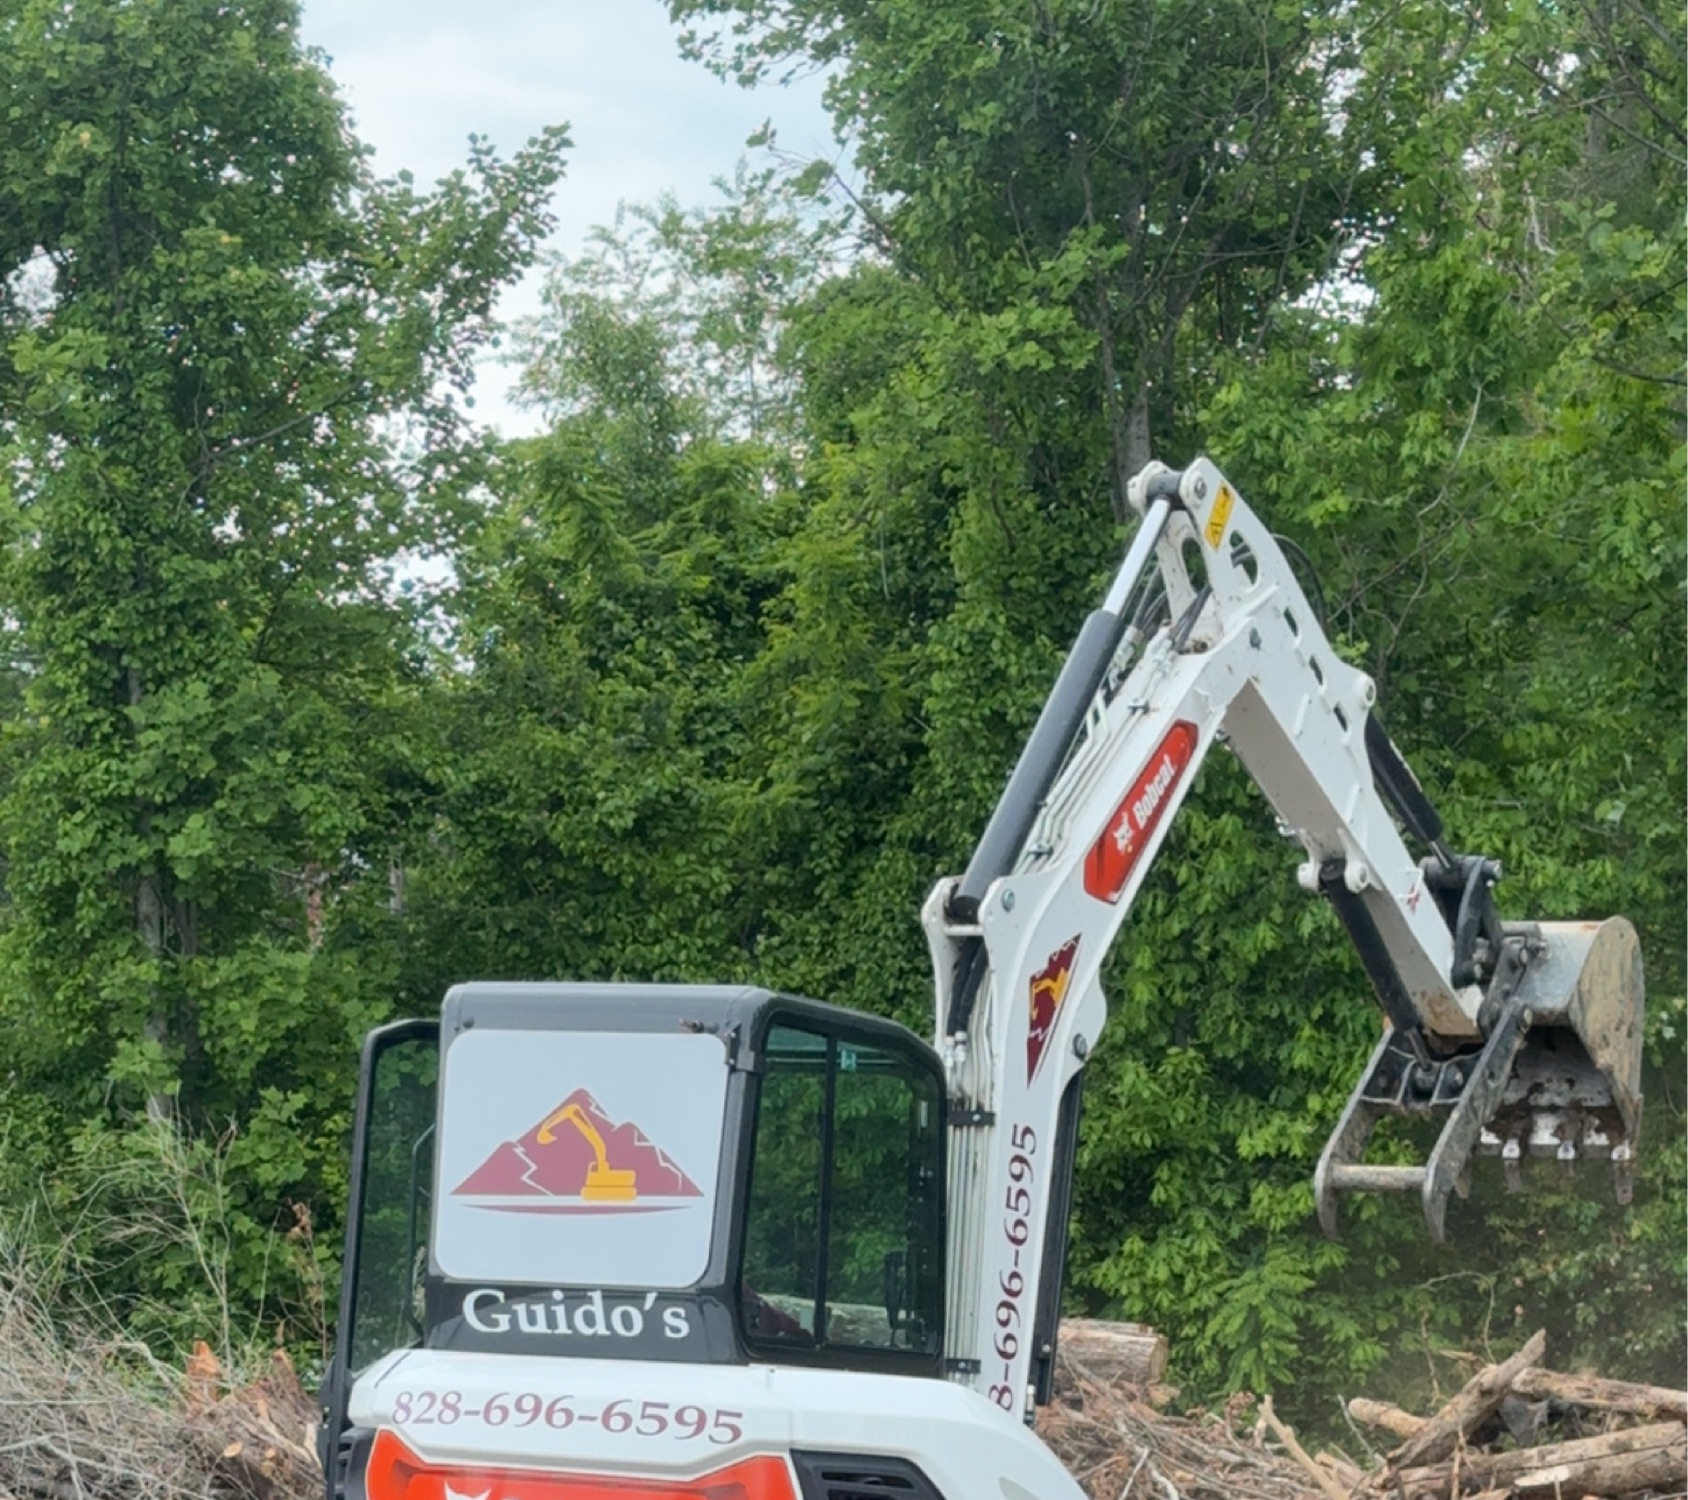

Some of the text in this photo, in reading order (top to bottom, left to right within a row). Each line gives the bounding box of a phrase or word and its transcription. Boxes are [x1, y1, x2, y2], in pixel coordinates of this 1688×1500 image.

[1132, 753, 1176, 830] Bobcat
[462, 1288, 690, 1338] Guido's
[392, 1390, 743, 1445] 828-696-6595
